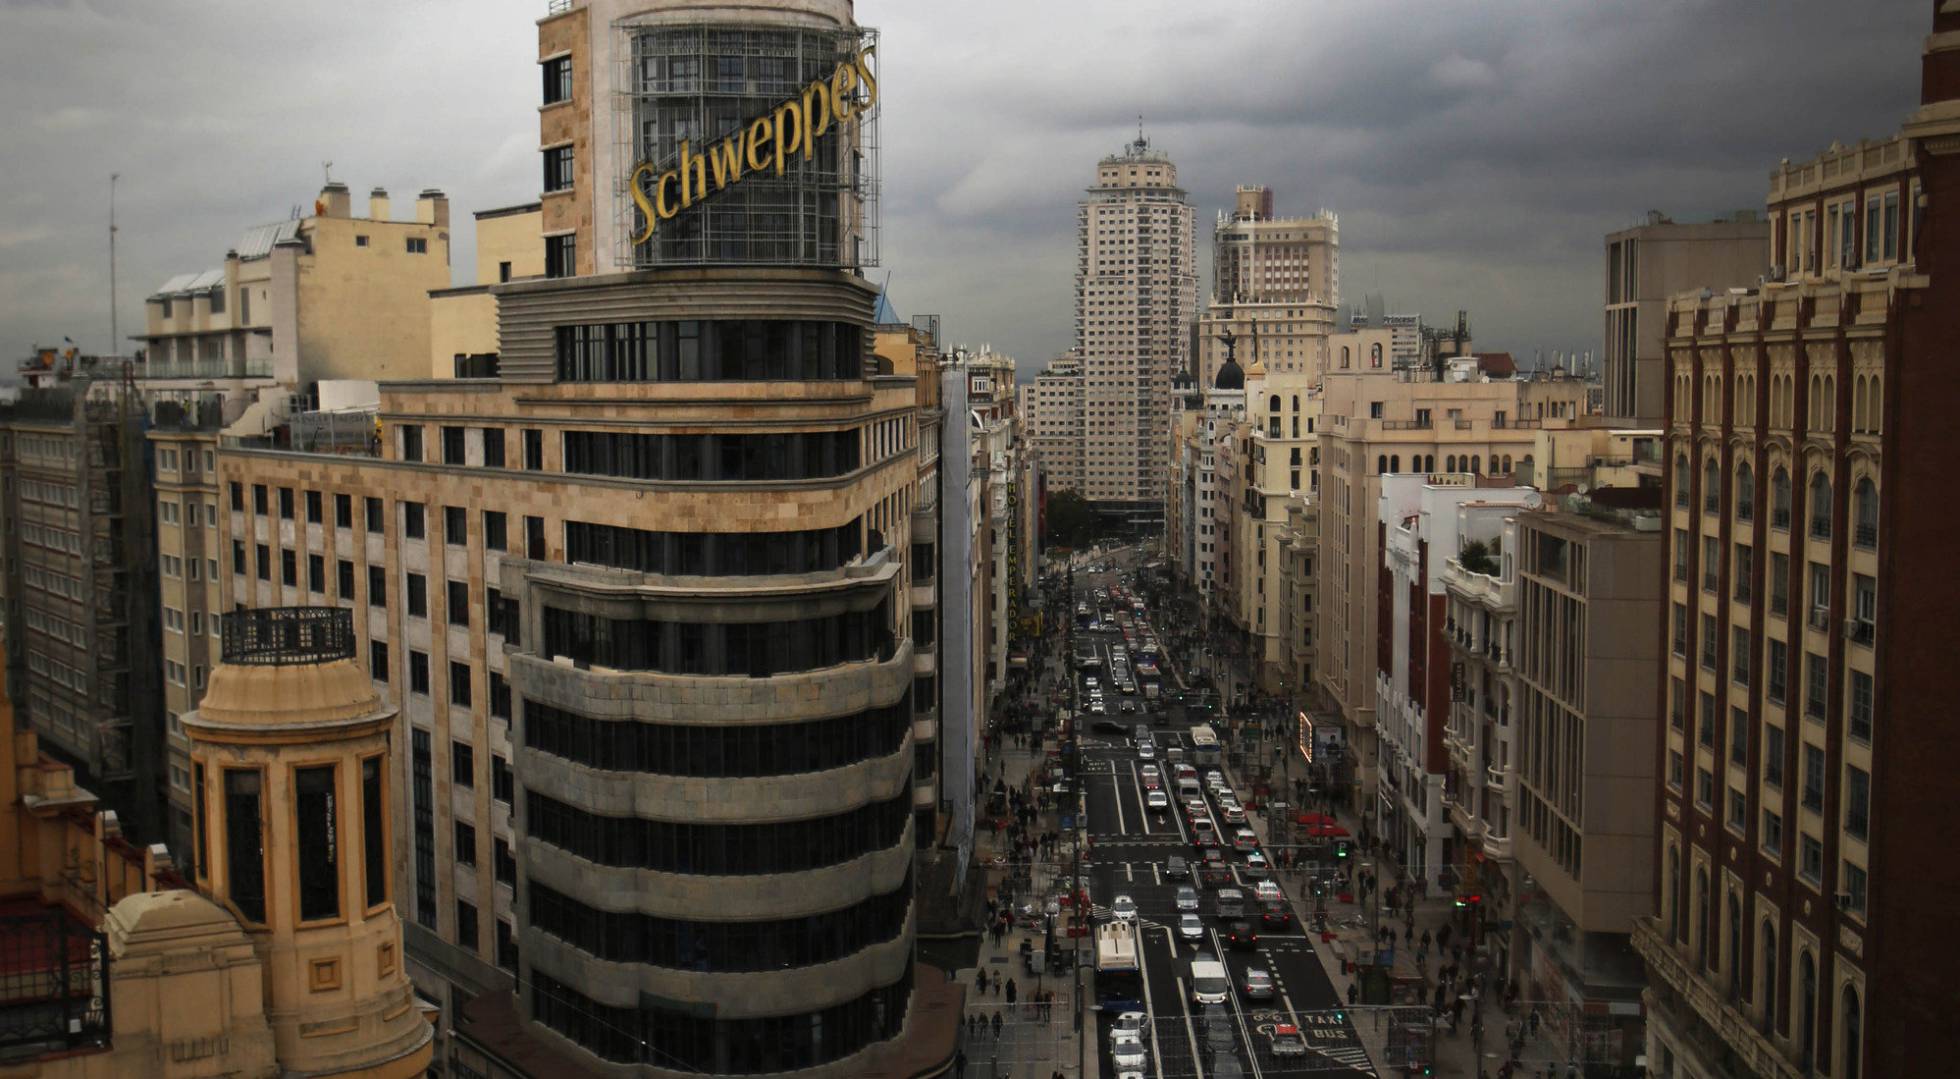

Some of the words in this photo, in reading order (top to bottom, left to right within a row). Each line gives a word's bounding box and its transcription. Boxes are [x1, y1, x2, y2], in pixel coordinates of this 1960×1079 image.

[629, 46, 877, 246] Schweppes
[1007, 483, 1017, 539] HOTEL
[1008, 545, 1017, 641] EMPERADOR
[1313, 1029, 1348, 1039] BUS
